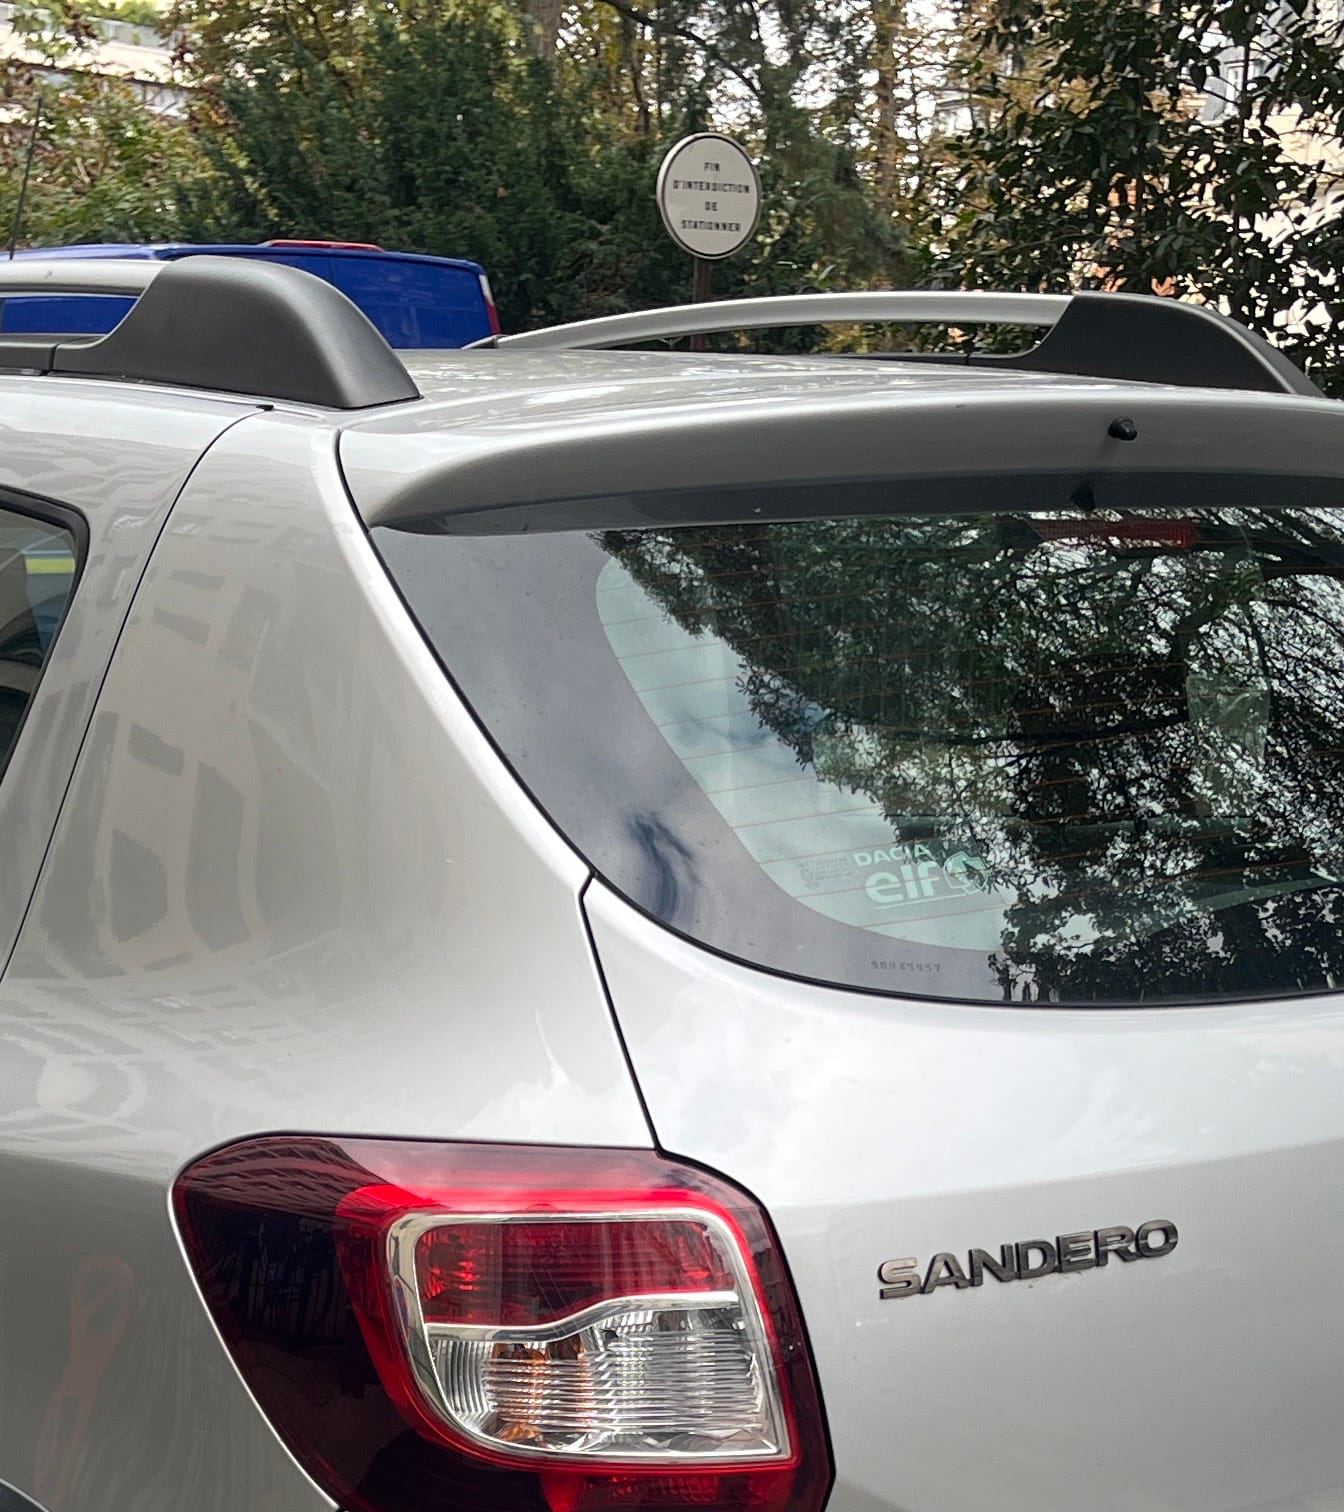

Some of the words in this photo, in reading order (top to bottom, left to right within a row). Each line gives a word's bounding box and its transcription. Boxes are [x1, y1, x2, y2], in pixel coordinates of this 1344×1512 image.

[704, 162, 720, 172] FIN
[672, 180, 749, 193] D'INTERDICTION
[704, 201, 718, 211] DE
[681, 219, 741, 232] STATIONNER
[854, 844, 932, 867] DACIA
[865, 860, 940, 904] elf
[877, 1219, 1179, 1300] SANDERO
